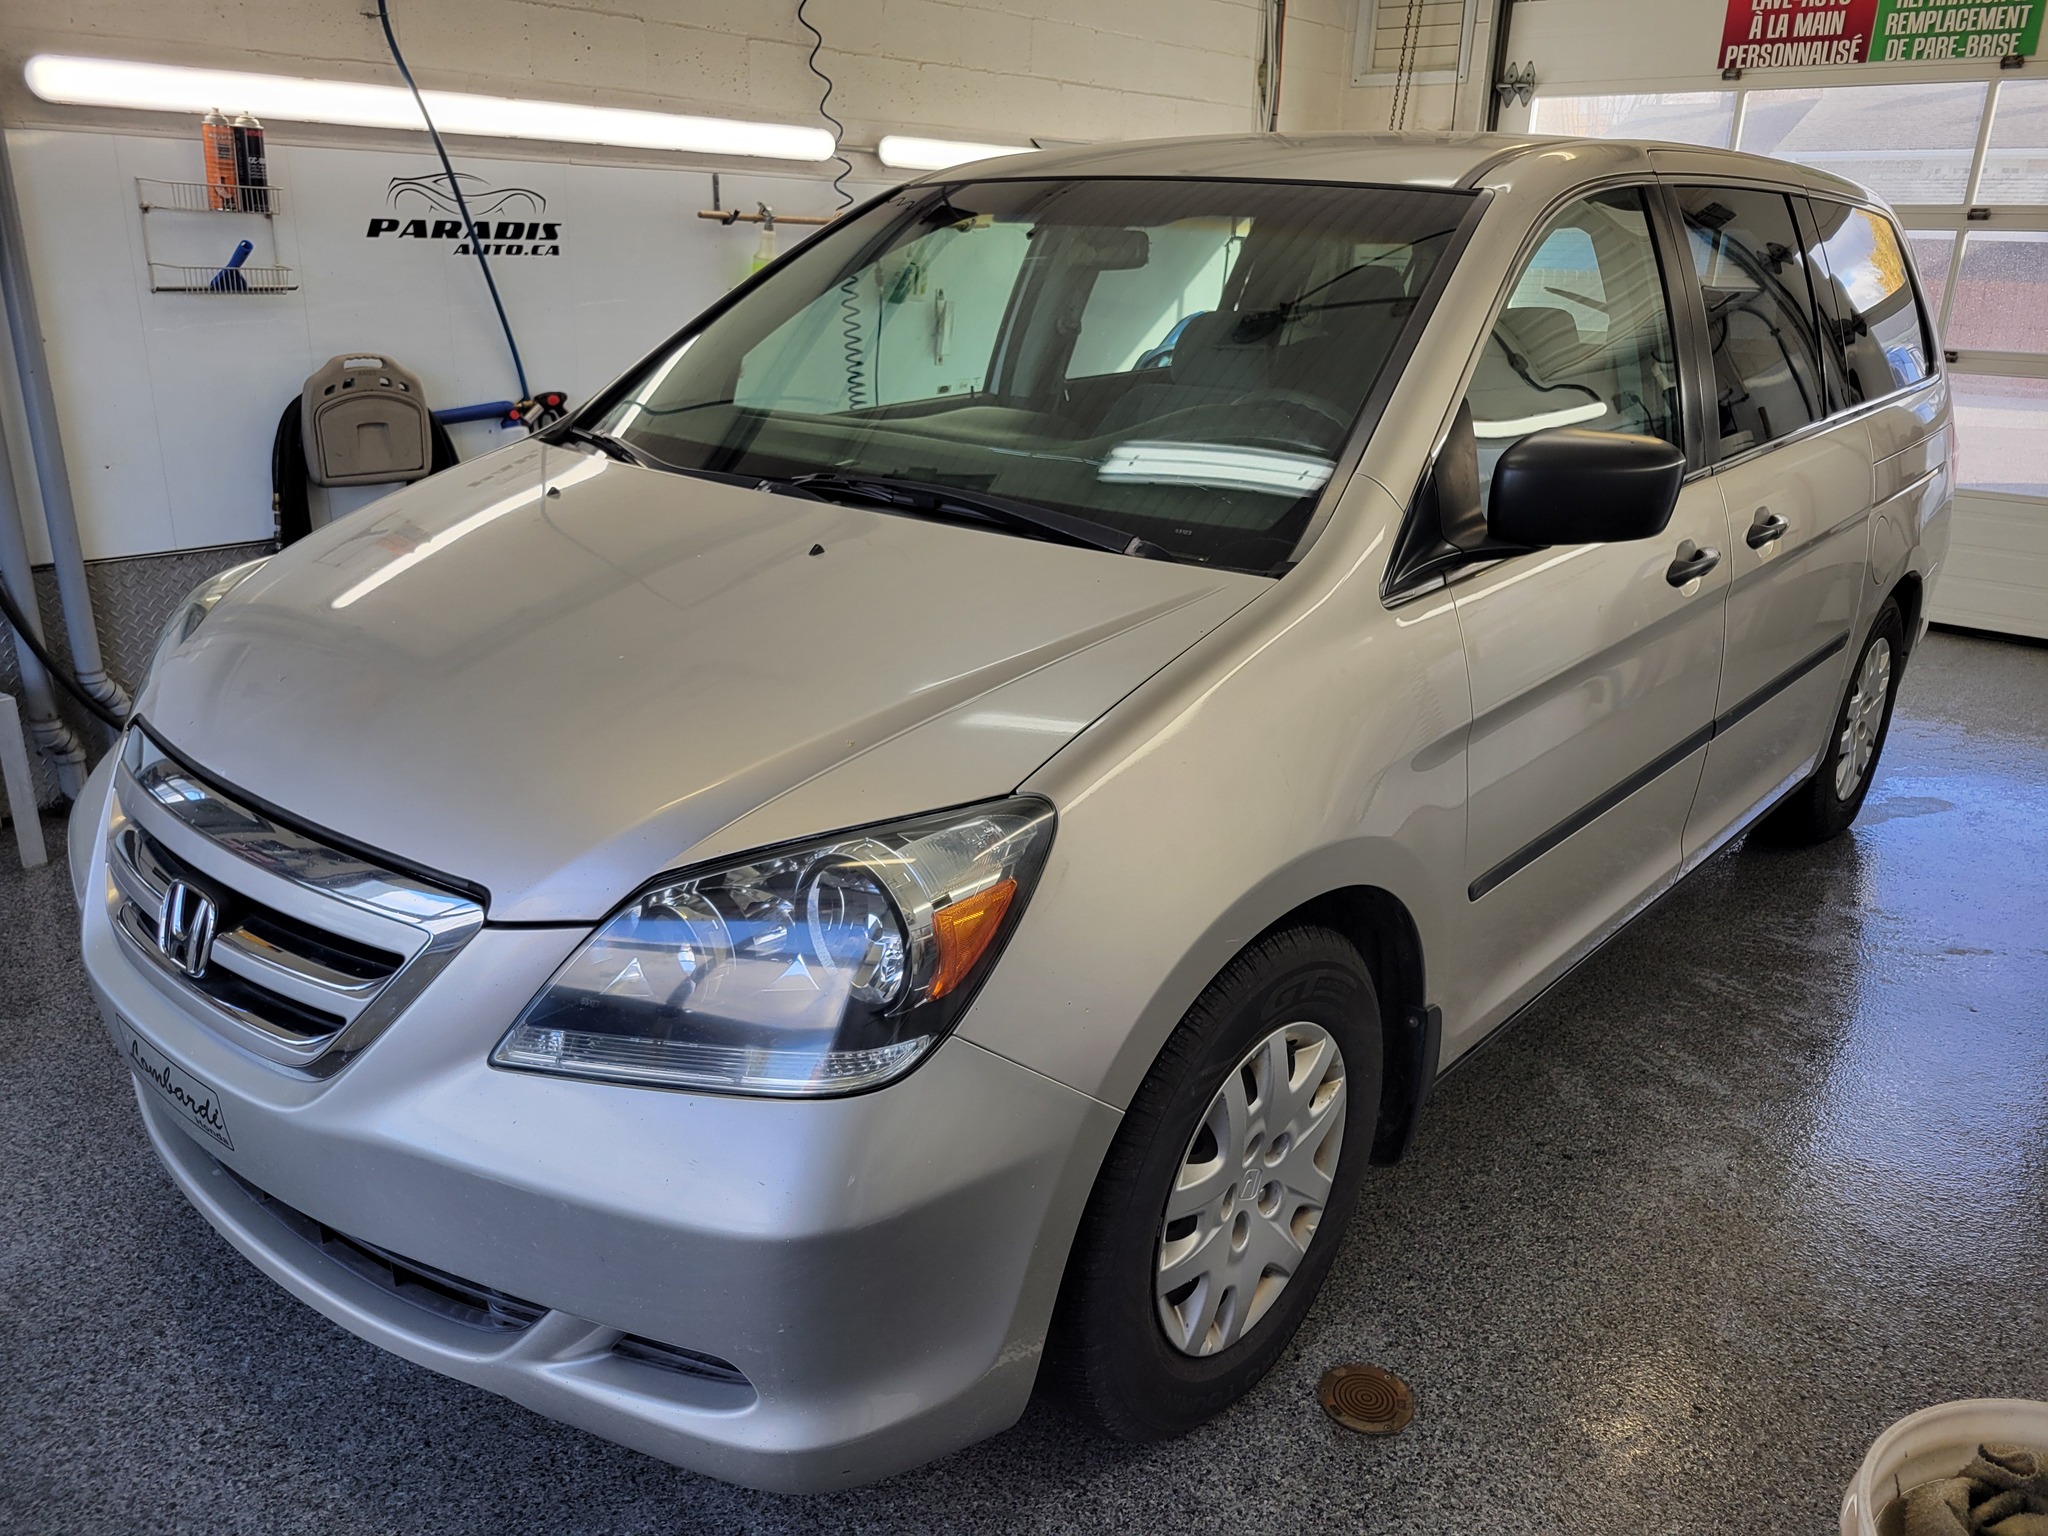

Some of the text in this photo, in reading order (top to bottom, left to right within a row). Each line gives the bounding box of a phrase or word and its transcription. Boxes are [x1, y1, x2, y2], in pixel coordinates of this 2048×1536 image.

[1748, 10, 1847, 40] À LA MAIN
[1884, 4, 2034, 36] REMPLACEMENT
[1724, 33, 1863, 69] PERSONNALISÉ
[1885, 33, 2022, 62] DE PARE-BRISE
[366, 218, 562, 241] PARADIS
[453, 243, 560, 256] AUTO.CA
[130, 1040, 223, 1130] Lombardi
